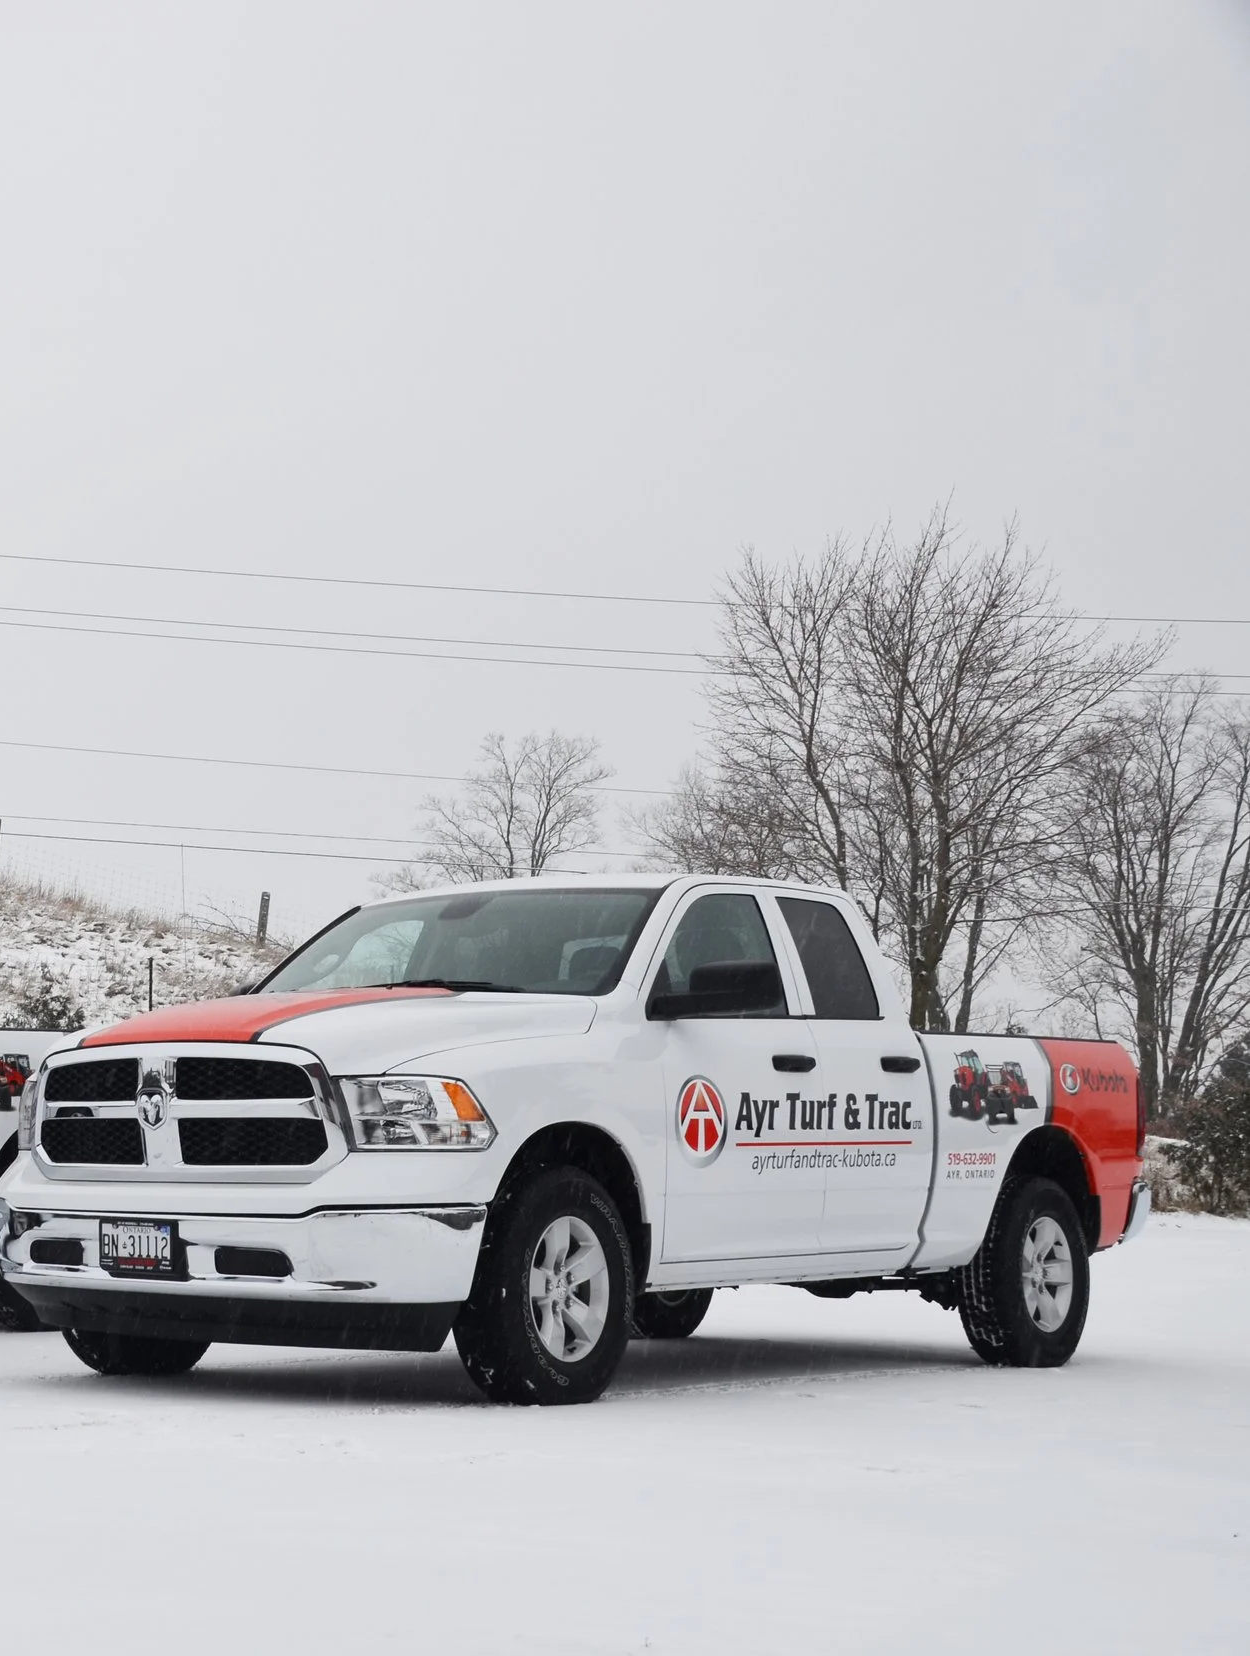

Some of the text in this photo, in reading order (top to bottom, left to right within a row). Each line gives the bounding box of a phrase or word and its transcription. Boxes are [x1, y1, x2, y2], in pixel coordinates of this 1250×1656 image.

[735, 1092, 780, 1138] Ayr
[785, 1092, 837, 1131] Turf
[844, 1093, 862, 1131] &
[865, 1093, 912, 1131] Trac
[751, 1148, 897, 1175] ayrturfandtrac-kubota.ca
[947, 1152, 997, 1166] 519-632-9901
[946, 1169, 995, 1180] AYR, ONTARIO
[103, 1234, 168, 1259] BN 31112
